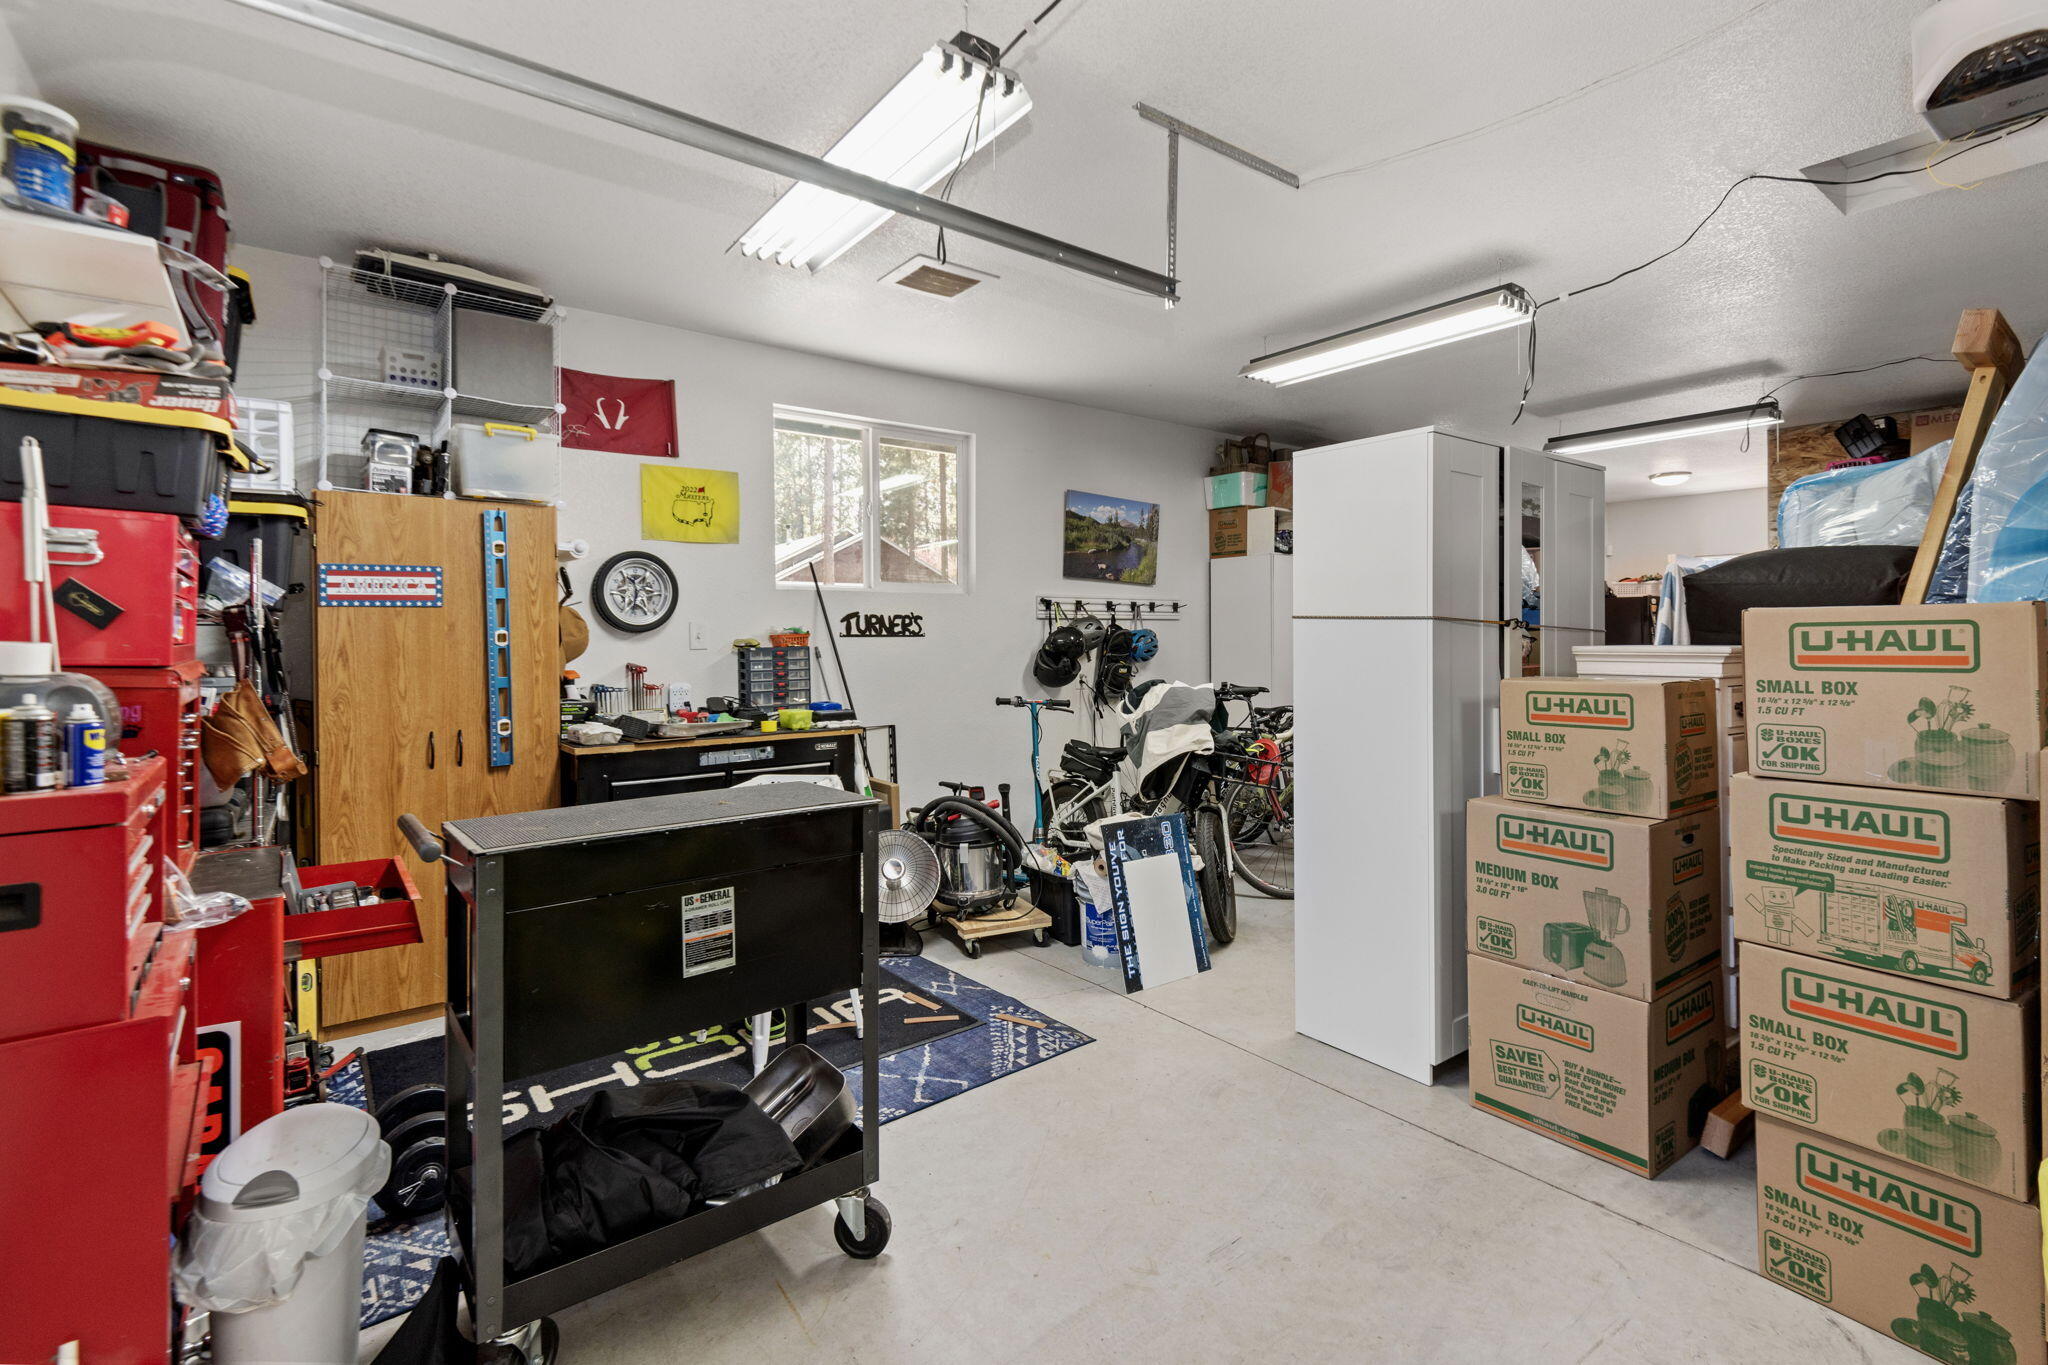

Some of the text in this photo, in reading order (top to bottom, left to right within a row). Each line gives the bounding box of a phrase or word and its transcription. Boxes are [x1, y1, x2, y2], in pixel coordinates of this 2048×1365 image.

[336, 577, 429, 594] AMERICA
[840, 611, 924, 636] TURNER'S
[1801, 629, 1966, 652] U-HAUL
[1756, 680, 1858, 695] SMALL BOX
[1533, 697, 1626, 716] U-HAUL
[1758, 706, 1805, 716] 1.5 CU FT
[1507, 730, 1566, 744] SMALL BOX
[1776, 730, 1820, 738] U-HAUL
[1781, 745, 1819, 762] OK
[1780, 762, 1820, 770] SHIPPING
[1522, 778, 1544, 790] OK
[1780, 802, 1937, 842] U-HAUL
[1117, 828, 1128, 860] FOR
[1504, 820, 1606, 854] U-HAUL
[1772, 845, 1950, 878] Specifically Sized and Manufactured
[1772, 854, 1780, 862] to
[1782, 856, 1807, 865] Make
[1809, 860, 1845, 874] Packing
[1848, 866, 1867, 876] and
[1869, 870, 1909, 884] Loading
[1475, 861, 1559, 890] MEDIUM BOX
[684, 889, 731, 906] US GENERAL
[1476, 885, 1511, 899] 3.0 CU FT
[1109, 841, 1136, 979] THE SIGN YOU'VE
[1916, 901, 1950, 914] U-HAUL
[1491, 935, 1512, 950] OK
[1522, 979, 1588, 1002] EASY-TO-LIFT HANDLES
[1669, 991, 1711, 1027] U-HAUL
[1793, 977, 1954, 1037] U-HAUL
[1521, 1008, 1588, 1040] U-HAUL
[1749, 1014, 1849, 1054] SMALL BOX
[1495, 1045, 1543, 1068] SAVE!
[1751, 1041, 1797, 1060] 1.5 CU FT
[1497, 1064, 1544, 1082] BEST PRICE
[1564, 1069, 1581, 1079] SAVE
[1583, 1075, 1601, 1086] EVEN
[1769, 1069, 1813, 1087] U-HAUL
[1769, 1075, 1812, 1094] BOXES
[1564, 1084, 1584, 1095] Prices
[1586, 1092, 1599, 1100] and
[1564, 1091, 1578, 1100] Give
[1580, 1097, 1592, 1106] You
[1581, 1082, 1592, 1091] Our
[1594, 1087, 1617, 1099] Bundle
[1773, 1086, 1811, 1110] OK
[1565, 1099, 1581, 1110] FREE
[1754, 1095, 1811, 1119] FOR SHIPPING
[1807, 1152, 1968, 1234] U-HAUL
[1763, 1185, 1864, 1239] SMALL BOX
[1765, 1212, 1812, 1237] 1.5 CU FT
[1783, 1241, 1826, 1266] U-HAUL
[1784, 1249, 1827, 1273] BOXES
[1770, 1267, 1826, 1297] FOR SHIPPING
[1788, 1261, 1825, 1289] OK
